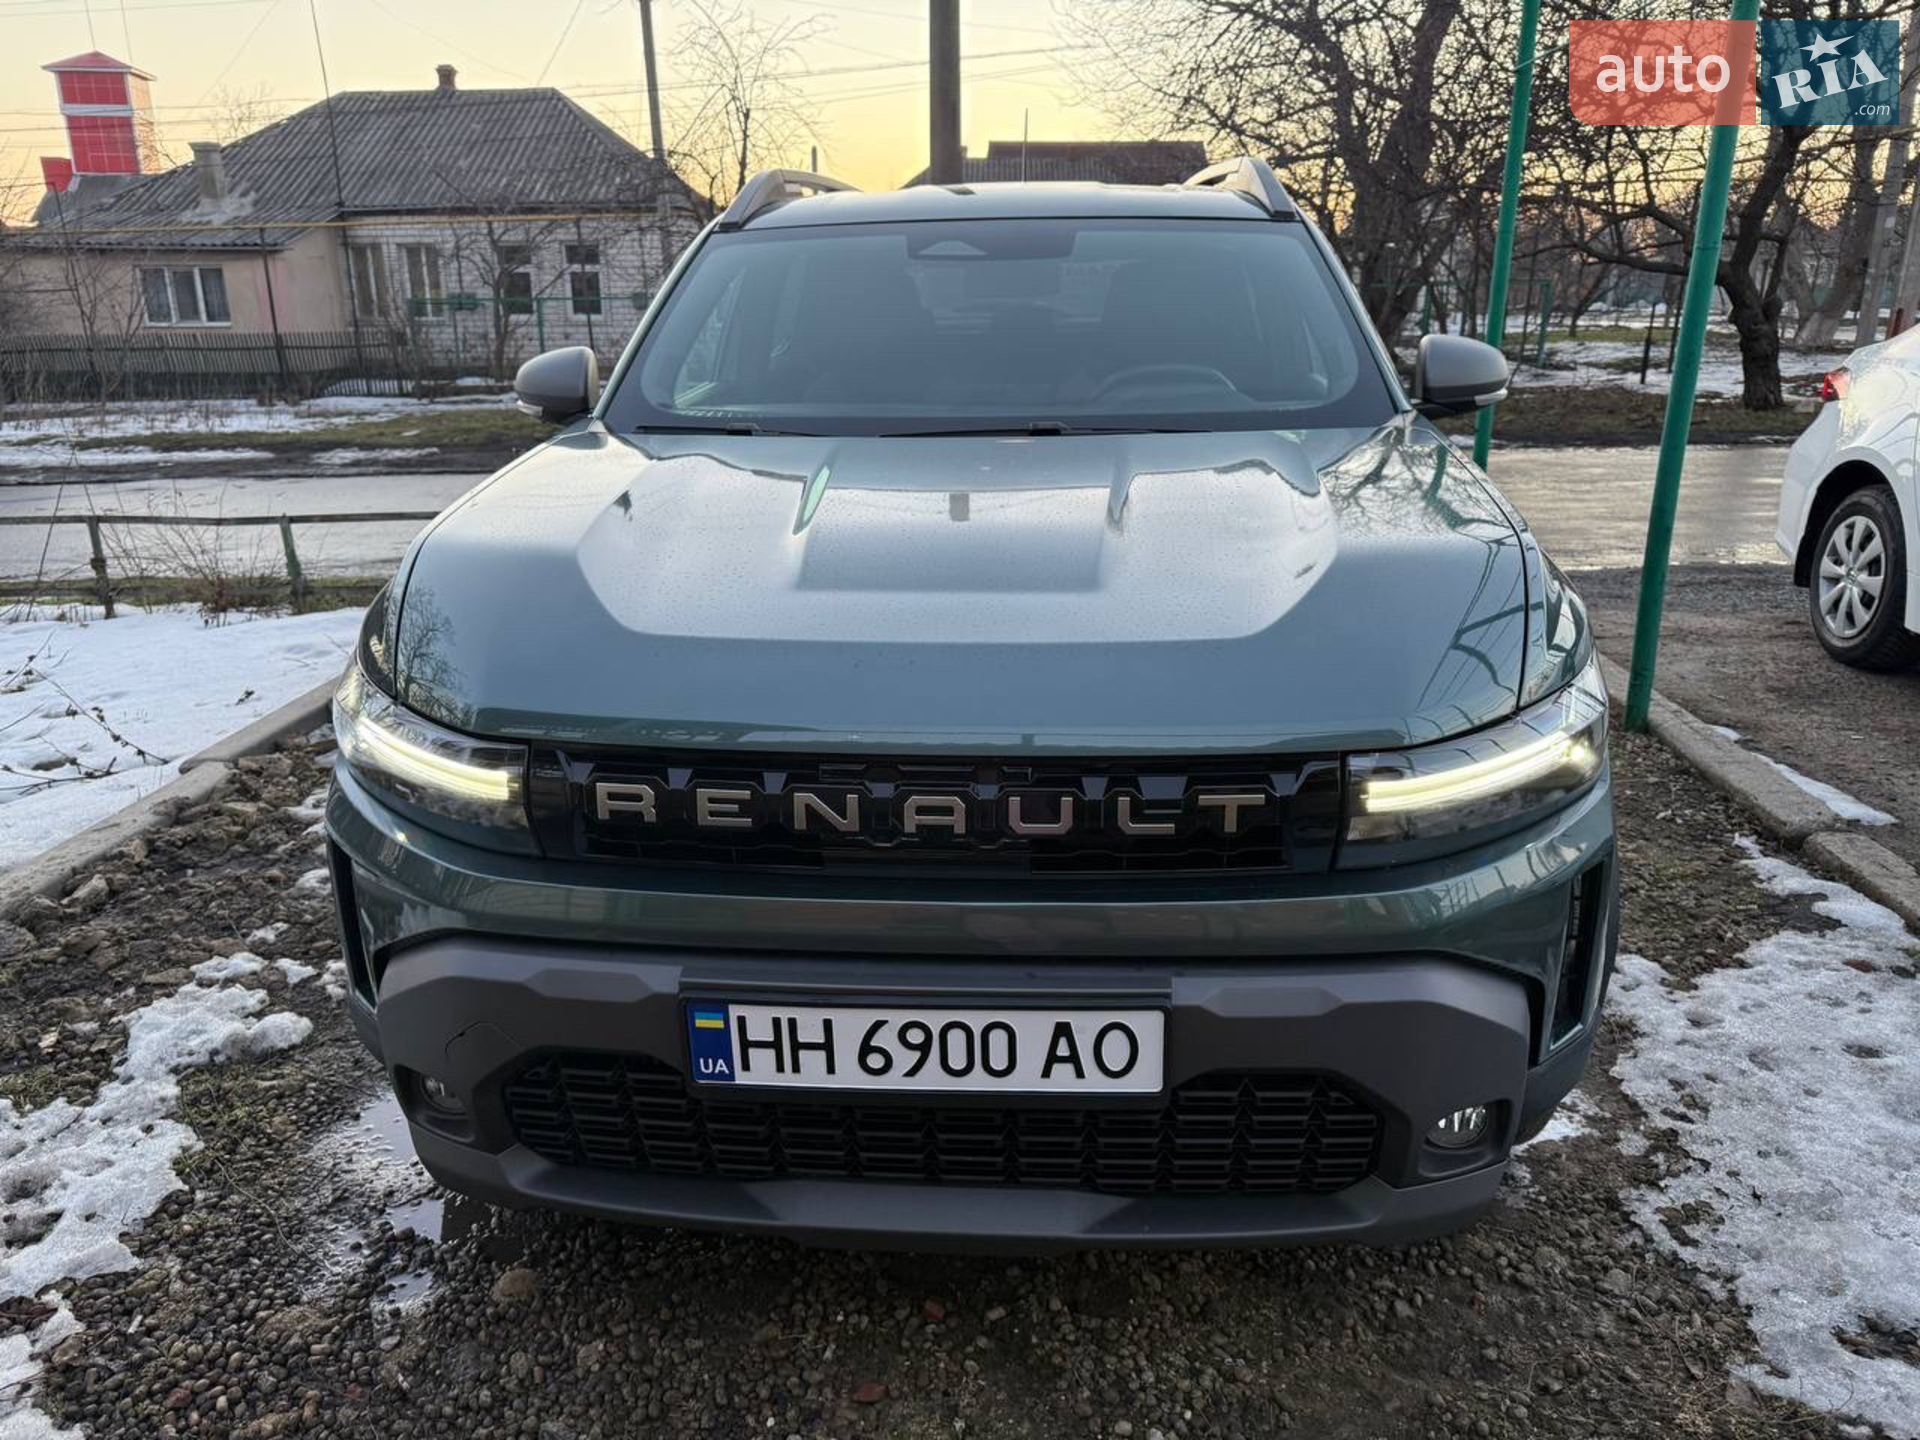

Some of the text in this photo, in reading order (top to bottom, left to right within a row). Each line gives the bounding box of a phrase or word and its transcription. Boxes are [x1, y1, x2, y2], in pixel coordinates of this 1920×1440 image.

[595, 782, 1266, 835] RENAULT
[699, 1058, 730, 1075] UA
[736, 1015, 1139, 1079] HH 6900 AO
